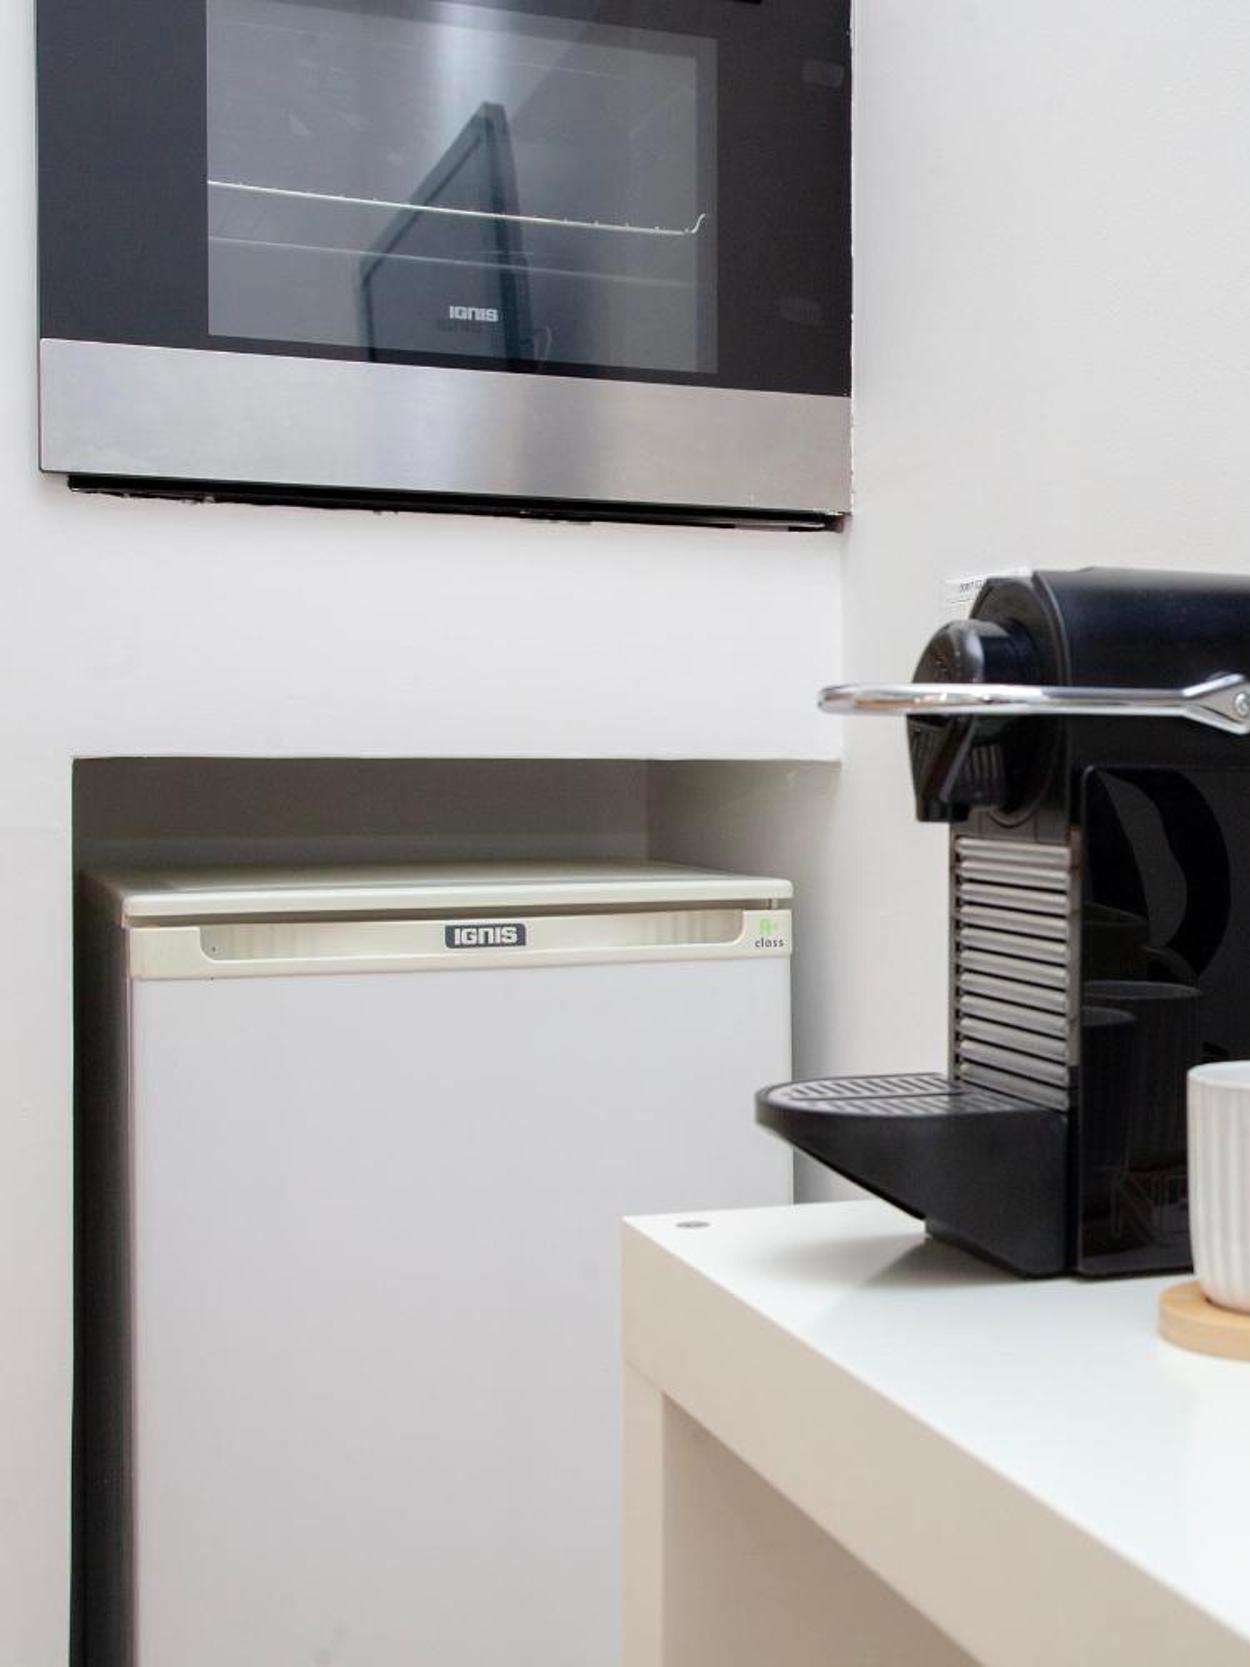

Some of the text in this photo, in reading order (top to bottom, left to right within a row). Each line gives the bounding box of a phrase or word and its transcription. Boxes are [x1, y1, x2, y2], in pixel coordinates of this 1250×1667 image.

[448, 305, 499, 323] IGNIS
[453, 926, 519, 946] IGNIS
[754, 936, 785, 948] class
